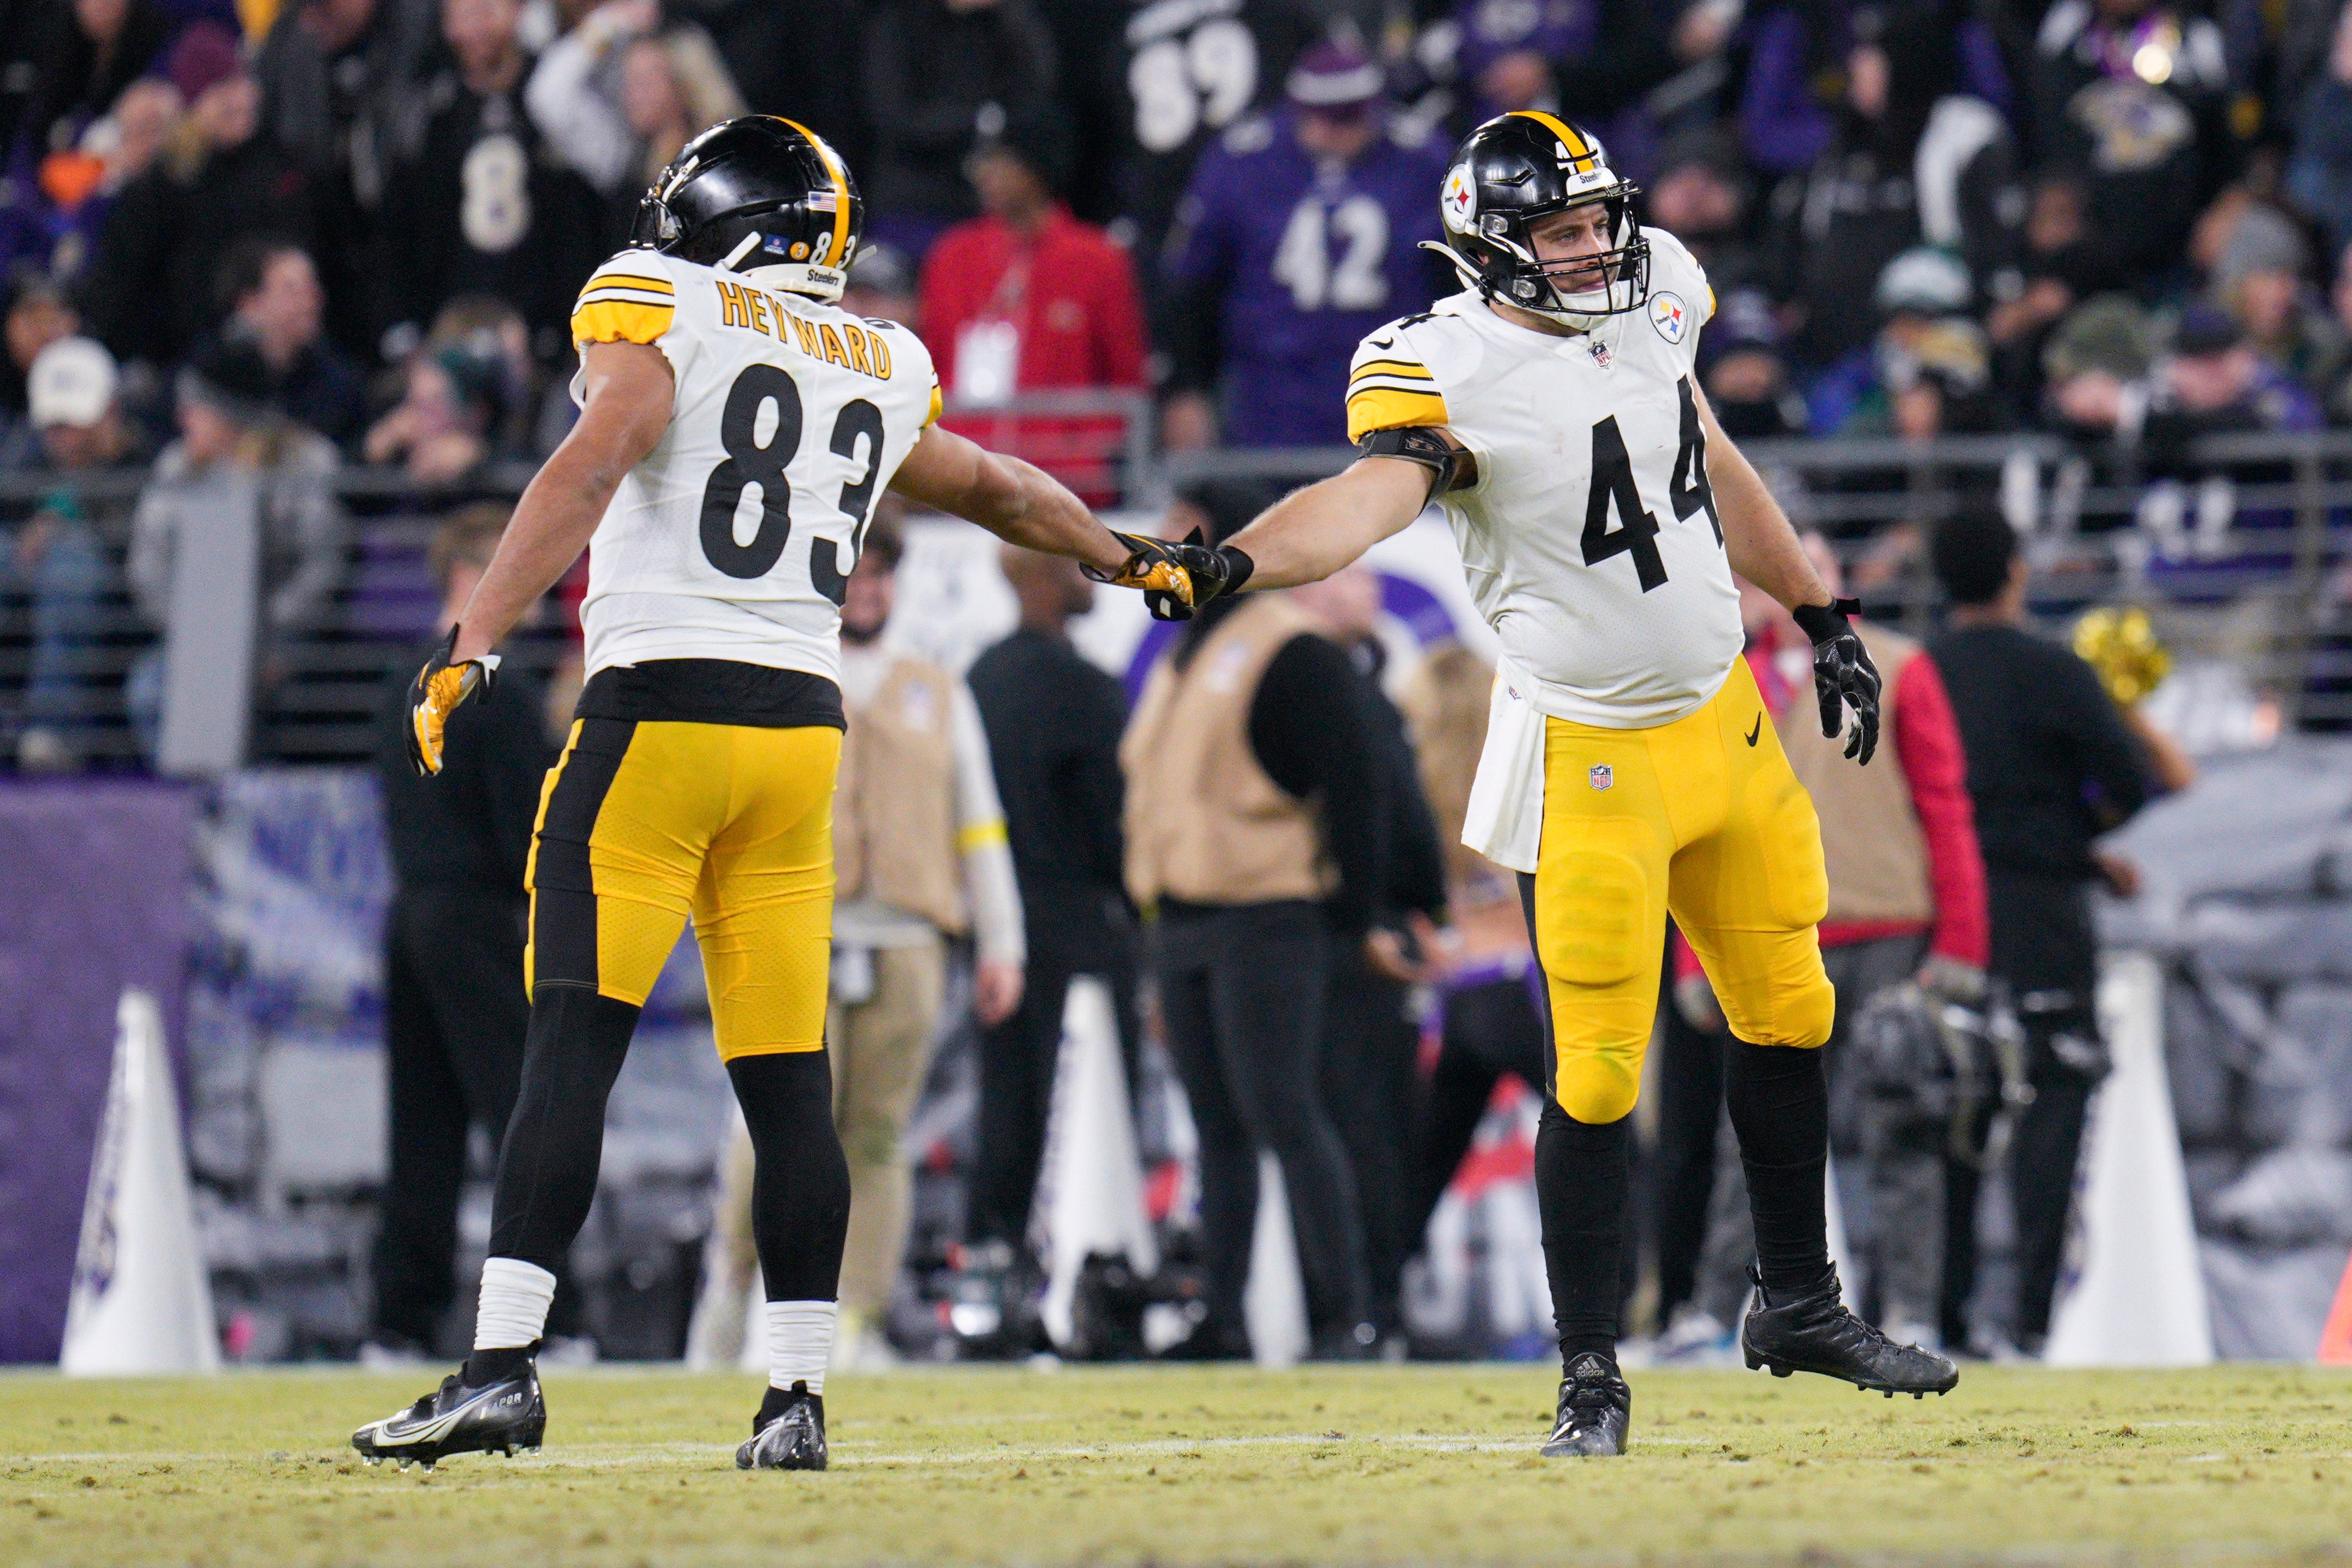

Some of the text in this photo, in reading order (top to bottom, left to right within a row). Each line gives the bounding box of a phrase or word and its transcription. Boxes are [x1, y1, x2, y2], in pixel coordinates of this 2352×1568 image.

[1579, 171, 1602, 183] Steel
[795, 243, 805, 258] 3
[809, 231, 856, 270] 83
[1273, 194, 1391, 311] 42
[807, 269, 839, 285] Steelers
[716, 281, 891, 380] HEYWARD
[1596, 351, 1611, 365] NFL
[700, 363, 884, 607] 83
[1580, 373, 1724, 593] 44
[1594, 776, 1610, 787] NFL
[1575, 1368, 1605, 1378] adidas
